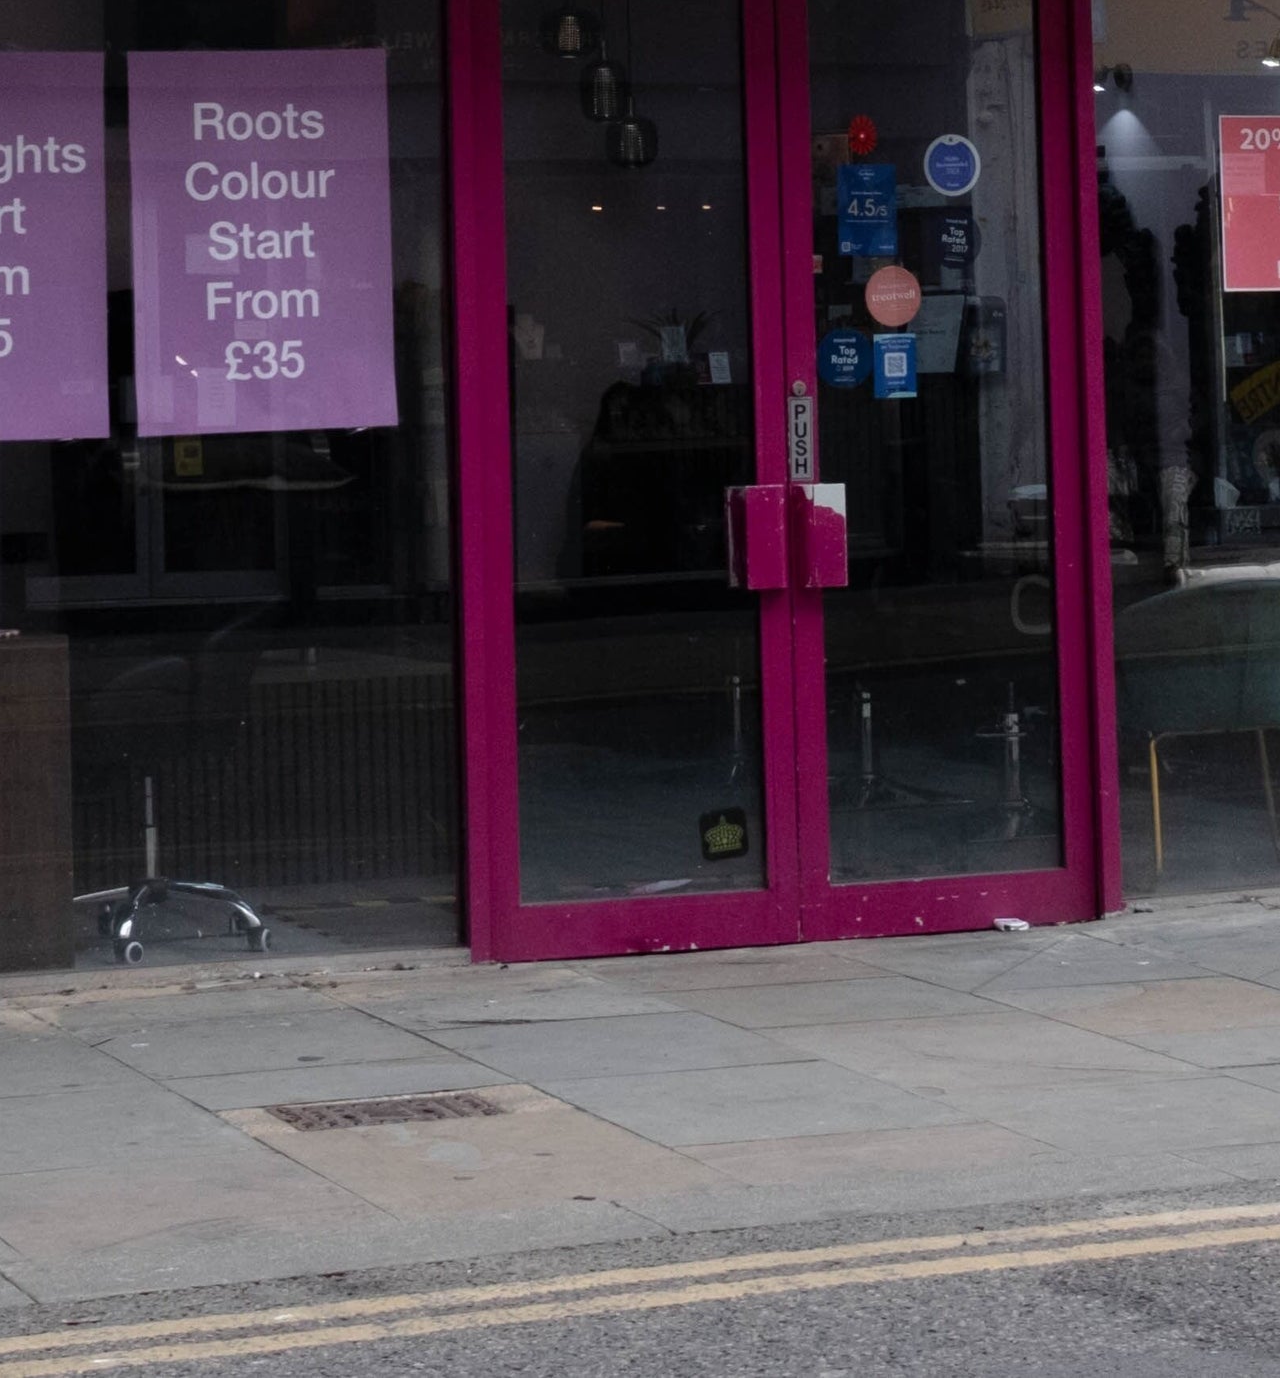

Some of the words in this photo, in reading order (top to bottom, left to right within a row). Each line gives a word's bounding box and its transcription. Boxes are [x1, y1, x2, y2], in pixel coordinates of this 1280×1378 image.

[193, 102, 326, 143] Roots
[184, 163, 335, 203] Colour
[847, 198, 889, 217] 4.5/5
[941, 233, 967, 245] Rated
[949, 226, 965, 239] Top
[207, 223, 315, 263] Start
[951, 244, 969, 254] 2017
[205, 282, 320, 321] From
[871, 290, 916, 303] treatwell
[830, 354, 859, 365] Rated
[839, 345, 856, 358] Top
[225, 342, 305, 382] £35
[794, 403, 808, 475] PUSH
